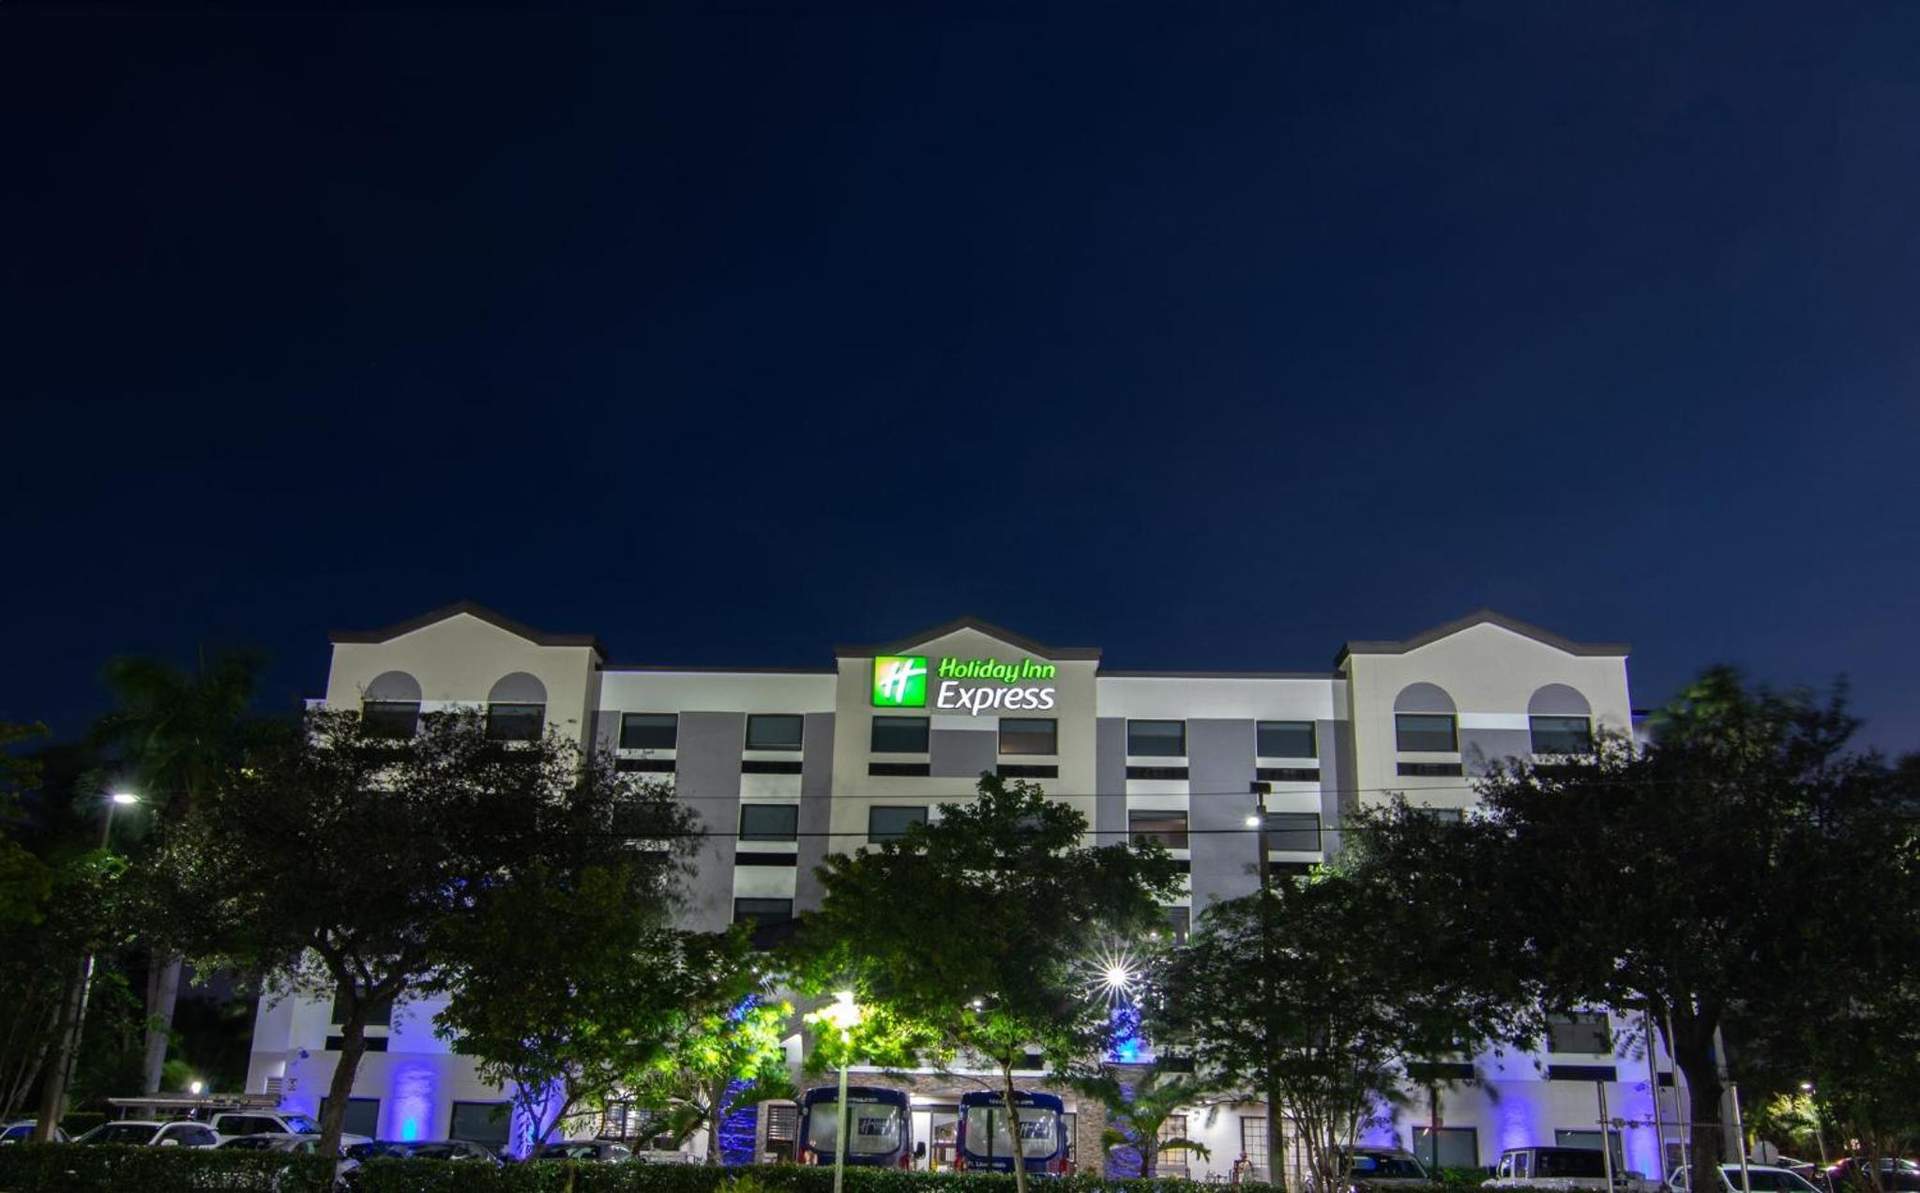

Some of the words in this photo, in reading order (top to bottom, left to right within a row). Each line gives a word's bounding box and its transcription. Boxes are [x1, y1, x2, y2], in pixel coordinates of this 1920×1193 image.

[938, 658, 1019, 683] Holiday
[1022, 659, 1056, 679] Inn
[936, 681, 1056, 716] Express
